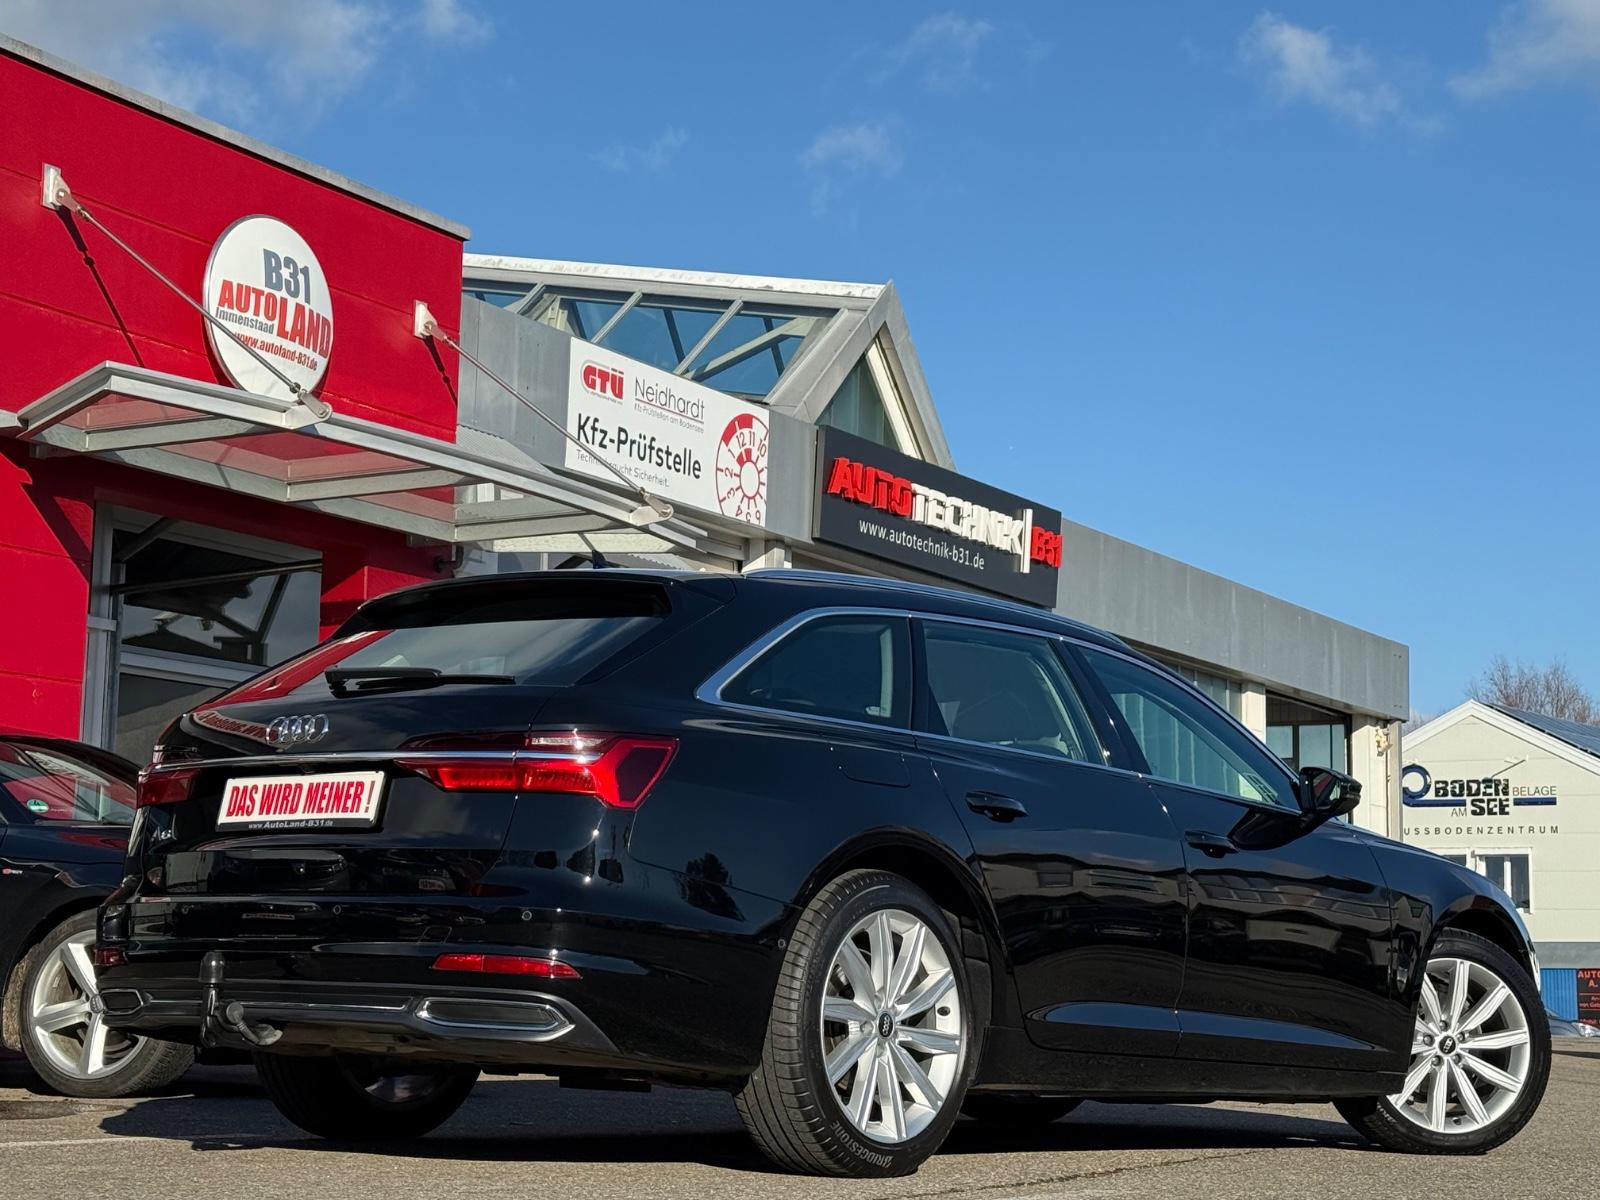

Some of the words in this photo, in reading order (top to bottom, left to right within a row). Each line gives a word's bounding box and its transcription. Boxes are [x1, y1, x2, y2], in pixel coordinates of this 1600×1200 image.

[263, 248, 311, 305] B31
[215, 306, 275, 335] Immenstaad
[218, 279, 332, 359] AUTOLAND
[583, 364, 625, 400] GTÜ
[634, 376, 705, 421] Neidhardt
[577, 412, 702, 480] Kfz-Prüfstelle
[736, 430, 747, 449] 12
[748, 430, 756, 447] 11
[724, 467, 734, 479] 2
[726, 487, 736, 500] 3
[859, 519, 985, 570] www.autotechnik-b31.de
[1030, 525, 1063, 568] B31
[225, 785, 258, 817] DAS
[258, 783, 304, 816] WIRD
[302, 781, 365, 815] MEINER
[1434, 778, 1510, 798] BODEN
[1450, 807, 1468, 817] AM
[1470, 798, 1510, 816] SEE
[248, 819, 334, 829] www.AutoLand-B31.de
[1403, 825, 1559, 836] USSBODENZENTRUM
[829, 1119, 894, 1169] BRIDGESTONE
